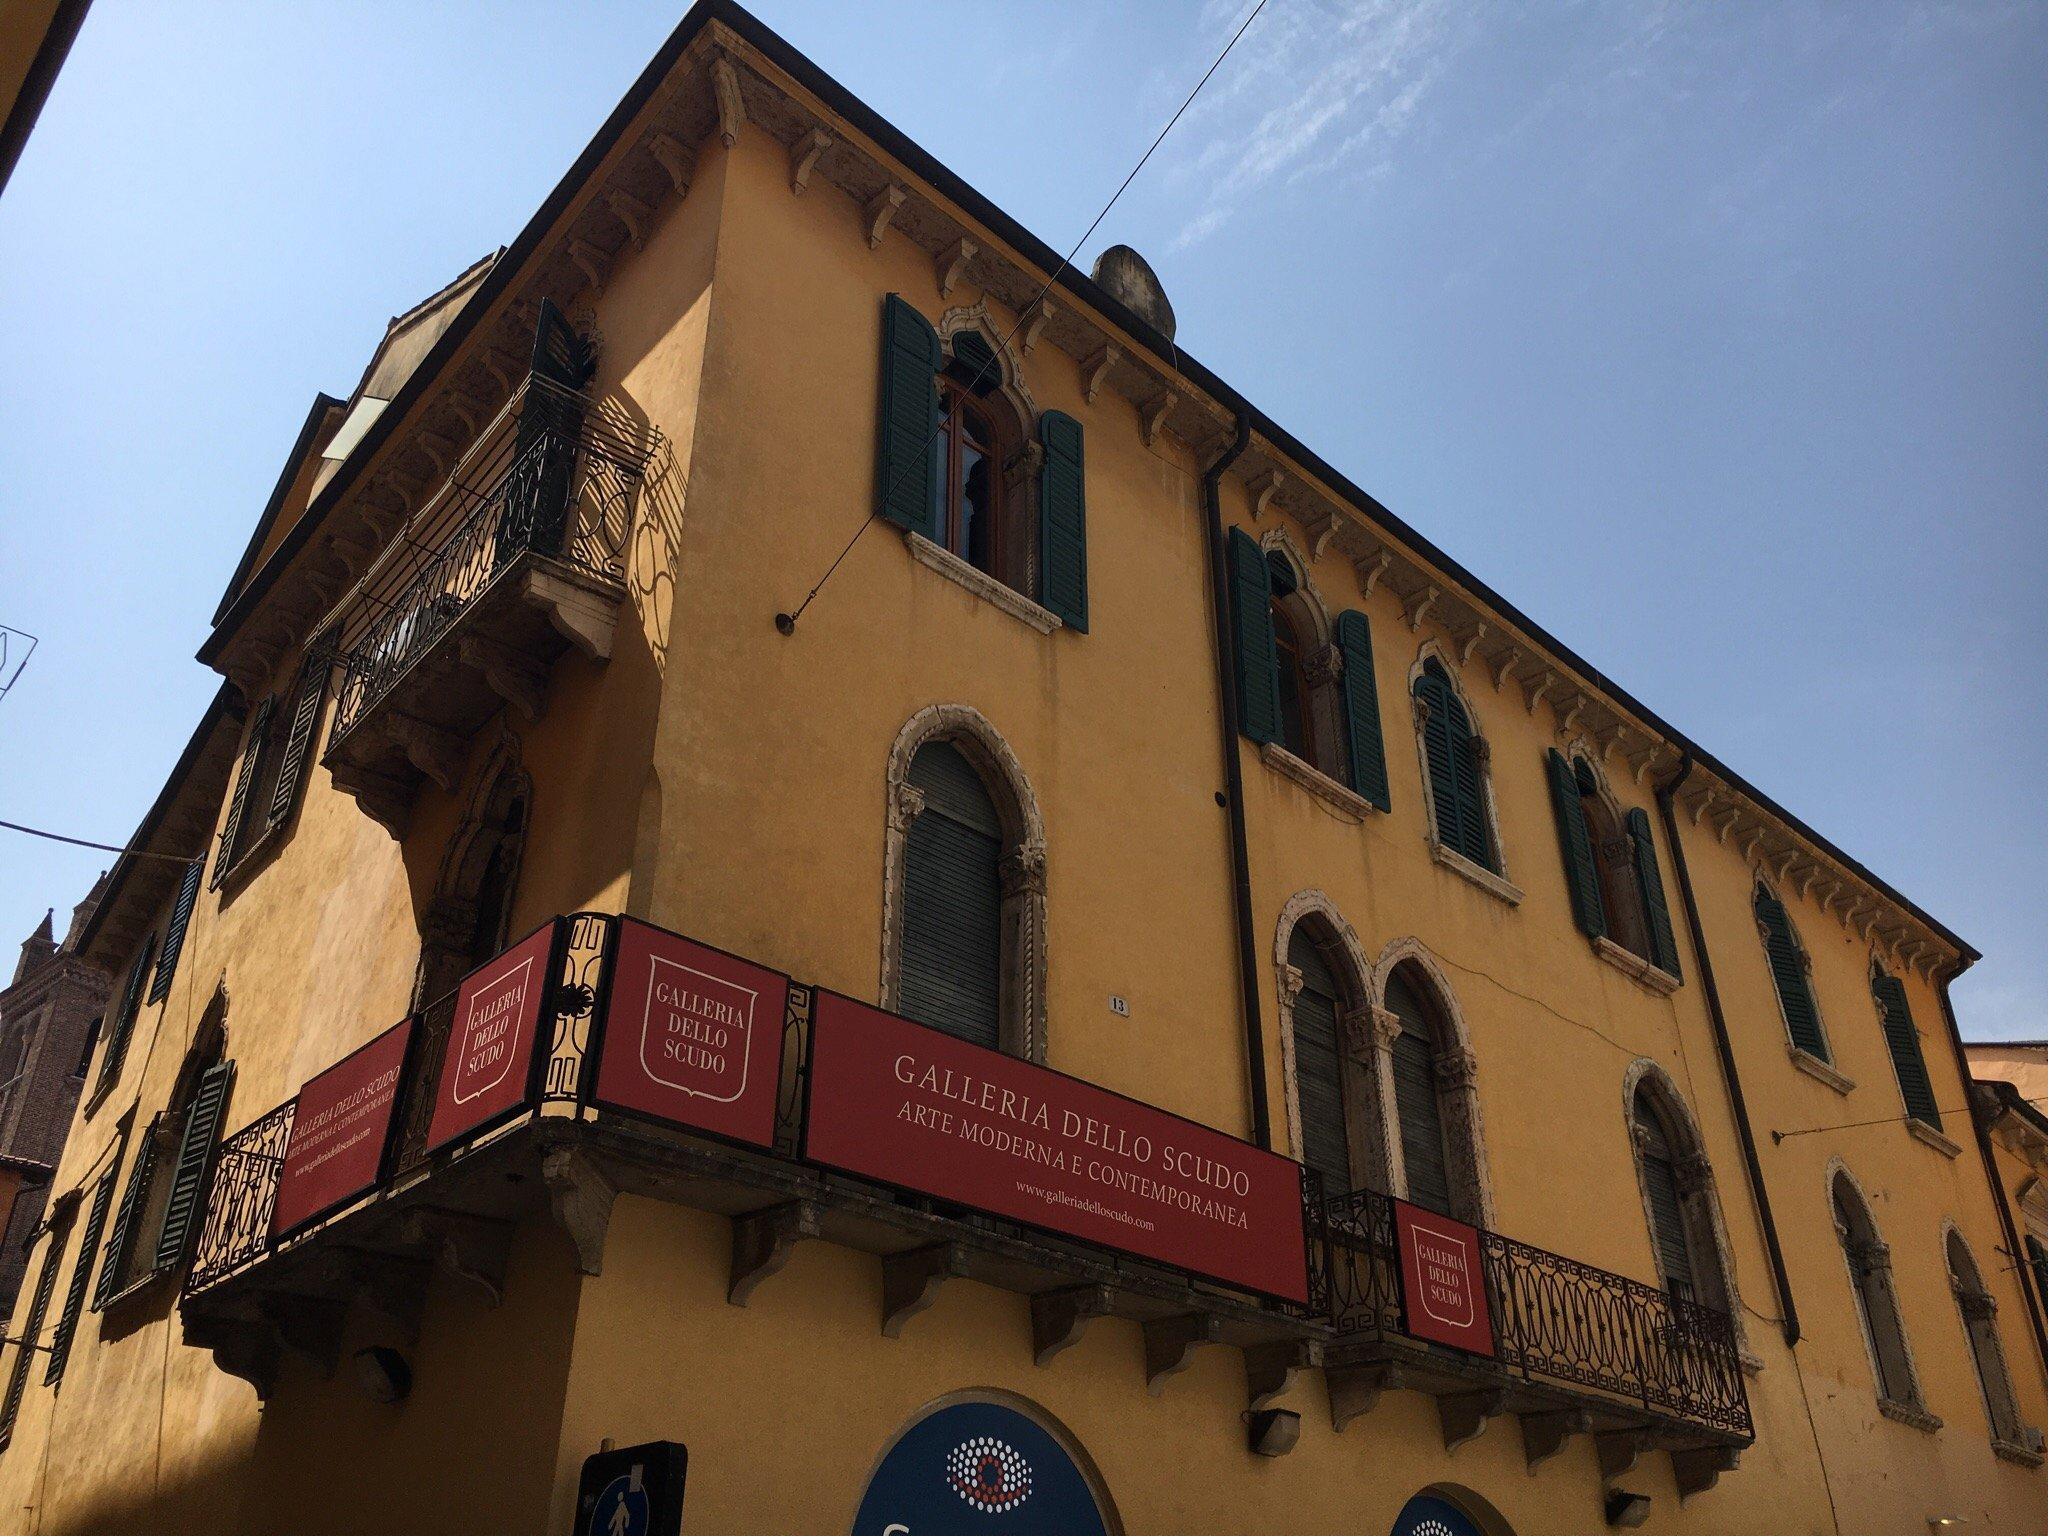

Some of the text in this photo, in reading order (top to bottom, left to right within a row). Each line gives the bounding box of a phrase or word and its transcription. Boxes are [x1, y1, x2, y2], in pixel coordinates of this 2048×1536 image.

[470, 985, 522, 1031] GALLERIA
[656, 982, 745, 1029] GALLERIA
[1112, 997, 1124, 1012] 13
[472, 1015, 509, 1052] DELLO
[667, 1012, 728, 1048] DELLO
[467, 1040, 505, 1077] SCUDO
[663, 1038, 726, 1074] SCUDO
[290, 1065, 400, 1144] GALLERIA DELLO SCUDO
[301, 1126, 332, 1151] MODERNA
[337, 1088, 395, 1131] CONTEMPORANEA
[894, 1054, 1250, 1197] GALLERIA DELLO SCUDO
[896, 1100, 1249, 1230] ARTE MODERNA E CONTEMPORANEA
[1016, 1180, 1155, 1232] www.galleriadelloscudo.com
[1418, 1243, 1465, 1272] GALLERIA
[1428, 1265, 1459, 1288] DELLO
[1430, 1284, 1462, 1307] SCUDO
